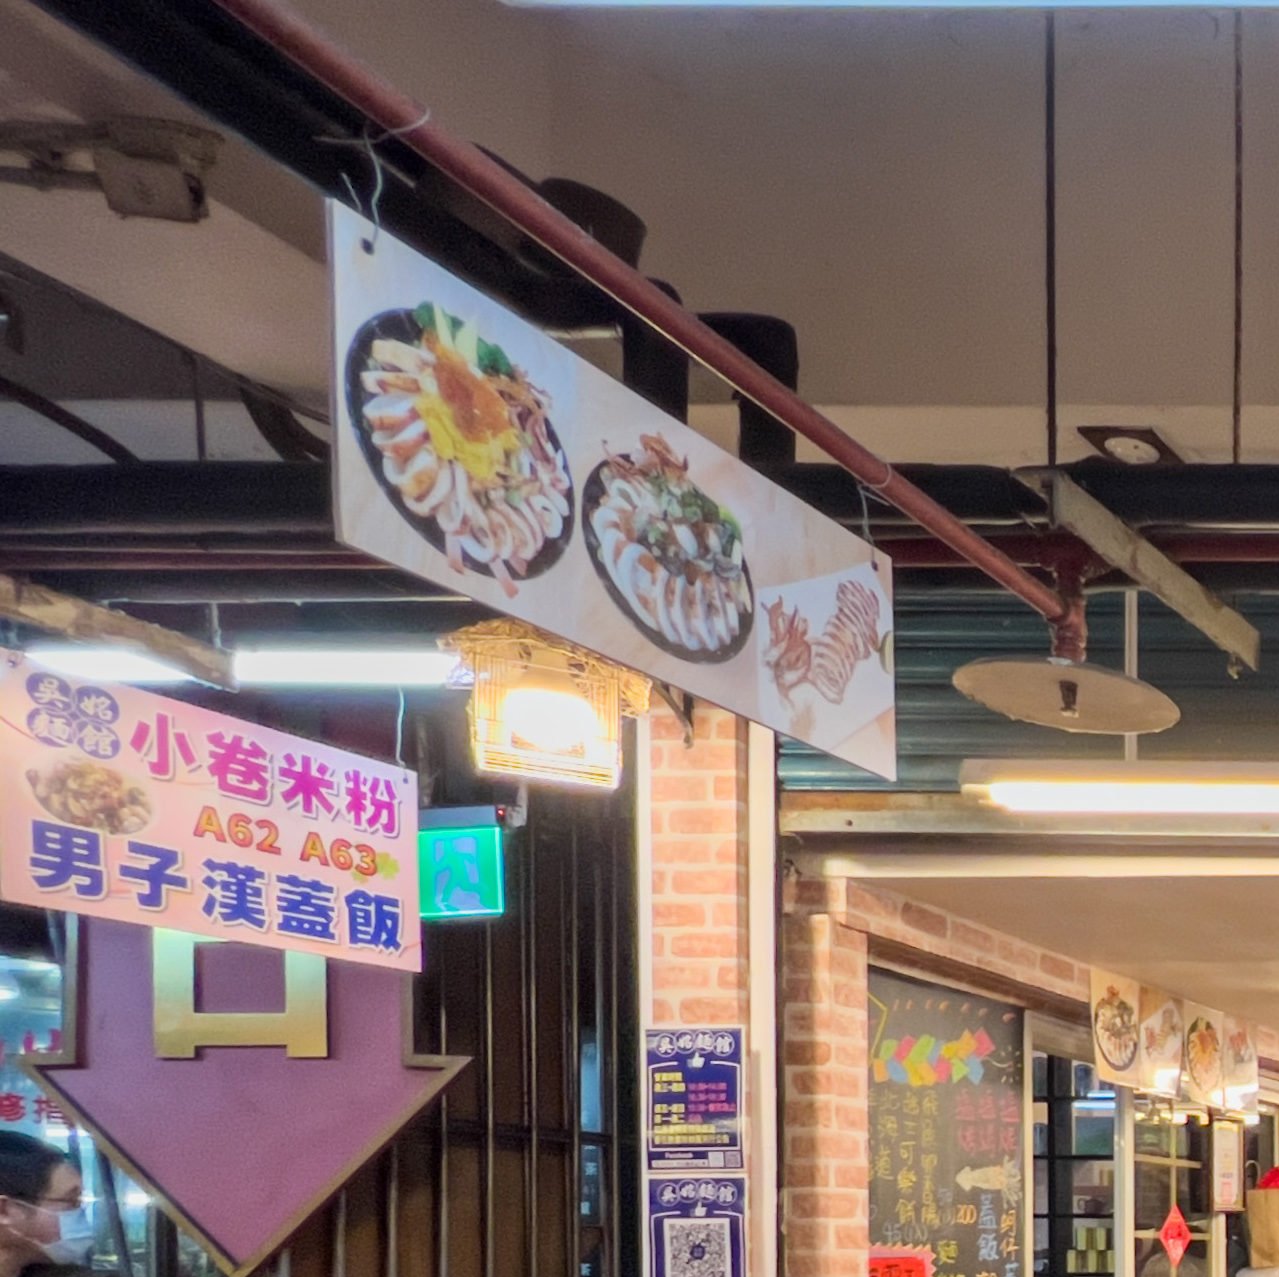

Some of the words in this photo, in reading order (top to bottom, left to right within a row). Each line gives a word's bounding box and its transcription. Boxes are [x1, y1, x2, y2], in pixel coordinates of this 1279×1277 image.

[129, 710, 401, 834] 小卷米粉
[29, 818, 403, 953] 男子漢蓋飯
[193, 806, 282, 856] A62
[299, 831, 378, 877] A63
